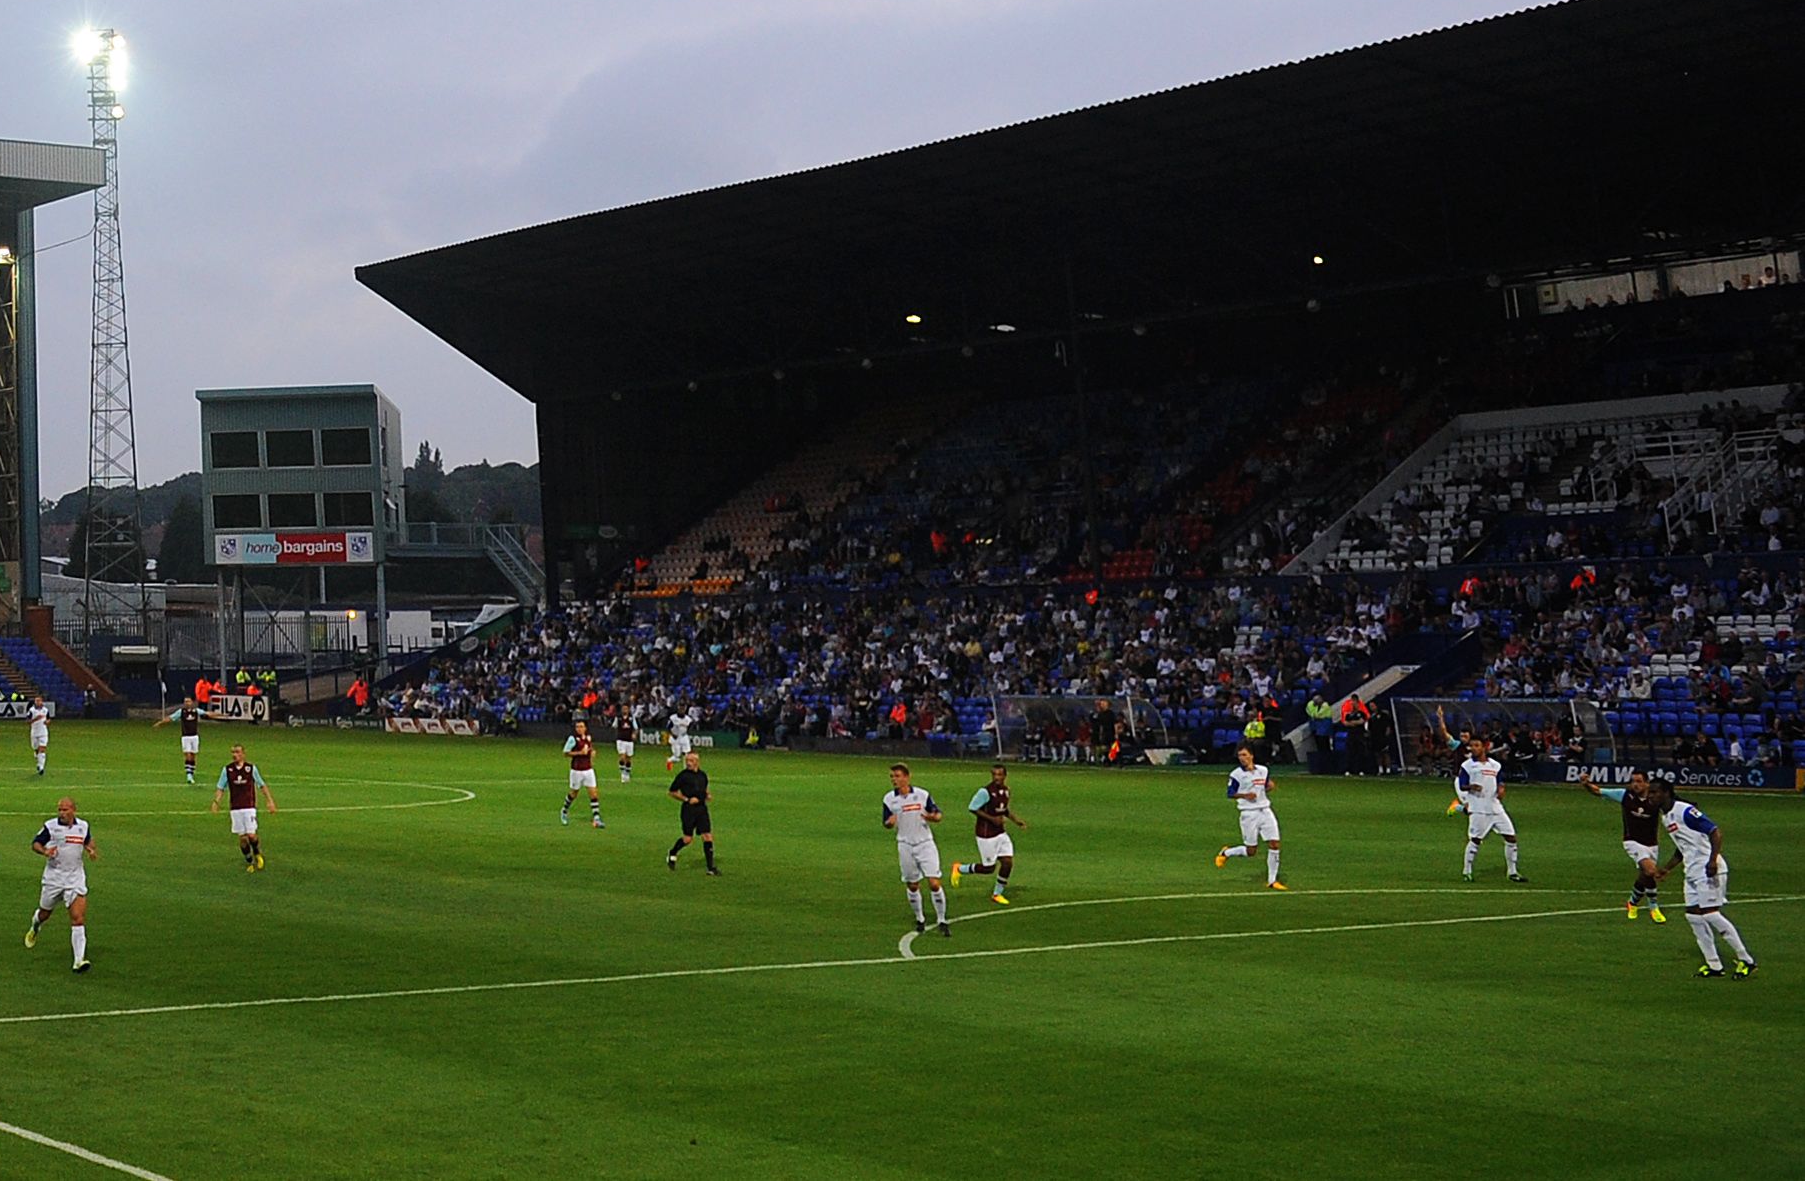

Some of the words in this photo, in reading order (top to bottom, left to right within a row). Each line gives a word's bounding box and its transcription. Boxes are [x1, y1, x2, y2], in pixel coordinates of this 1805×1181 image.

[245, 542, 280, 554] home
[283, 539, 344, 556] bargains
[211, 696, 242, 717] FILA
[1678, 766, 1742, 786] Services
